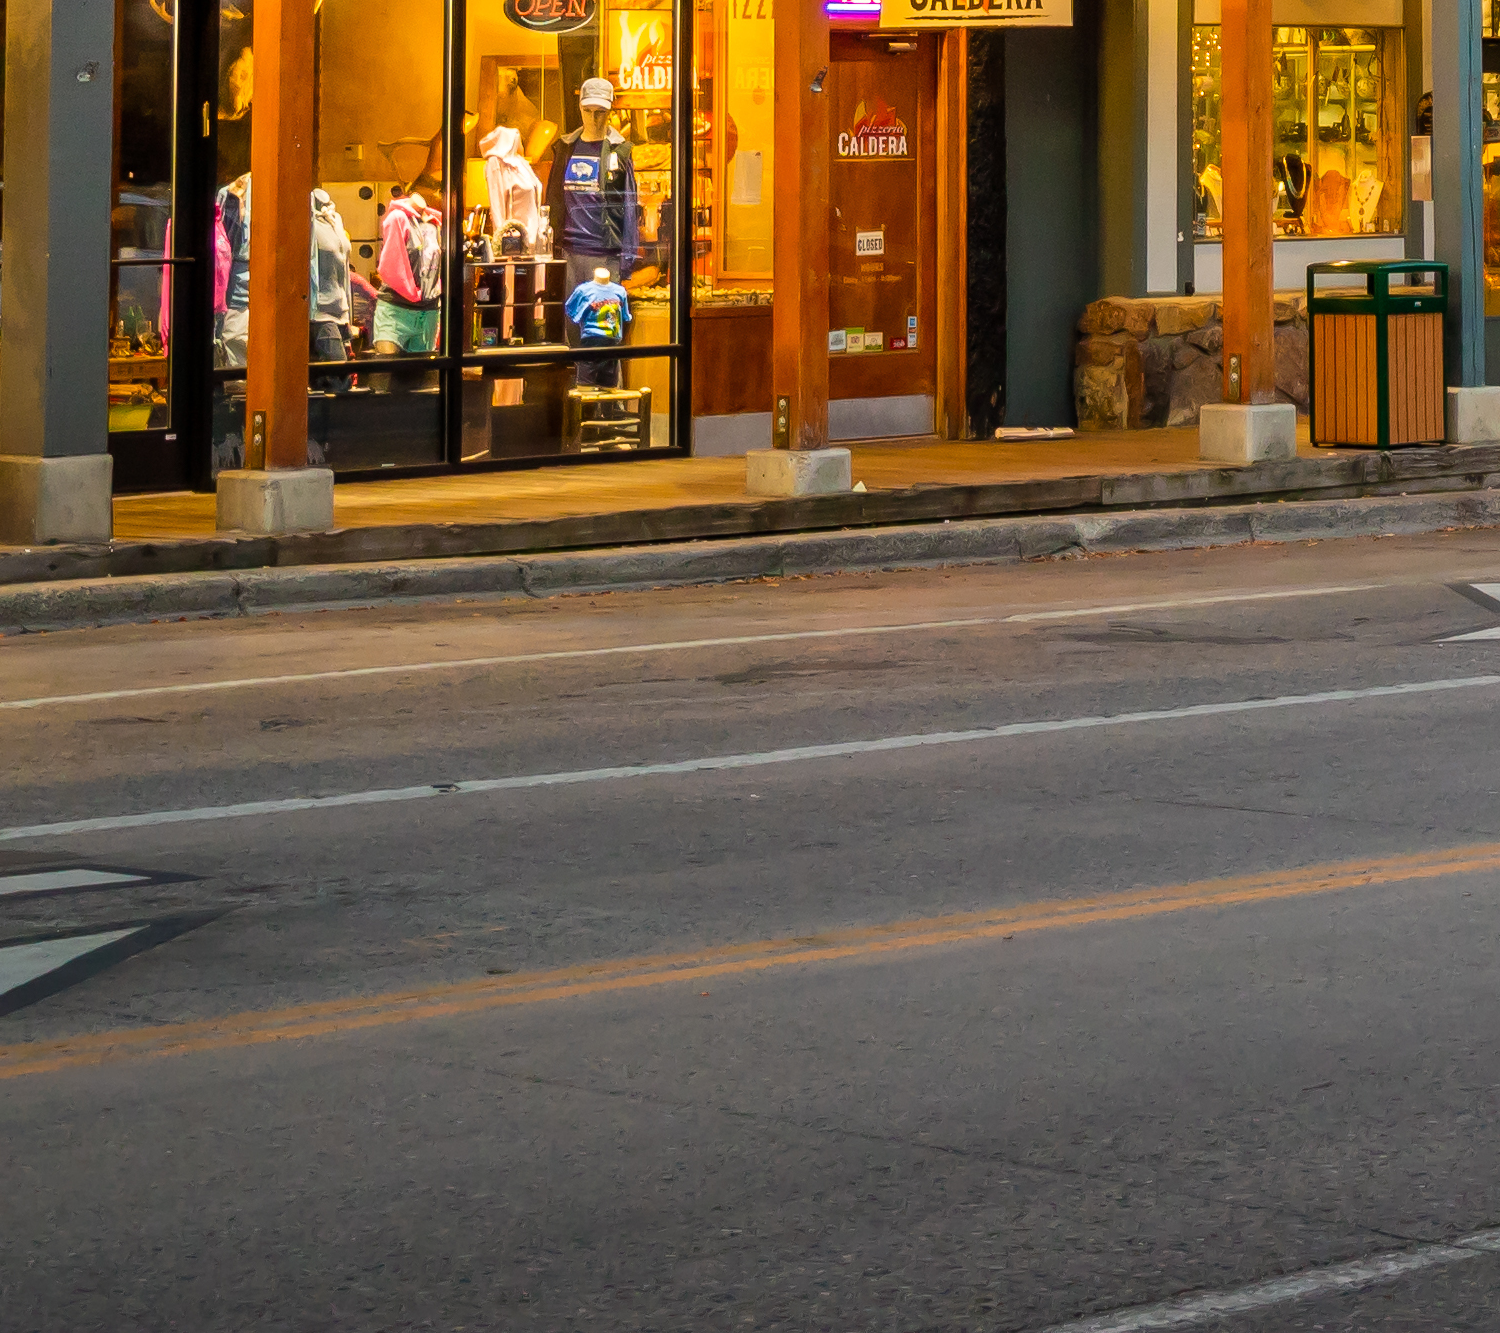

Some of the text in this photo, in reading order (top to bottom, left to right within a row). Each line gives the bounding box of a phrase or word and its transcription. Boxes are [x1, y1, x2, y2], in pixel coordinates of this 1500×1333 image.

[858, 123, 905, 137] pizzeria
[838, 132, 908, 157] CALDERA
[857, 237, 883, 253] CLOSED
